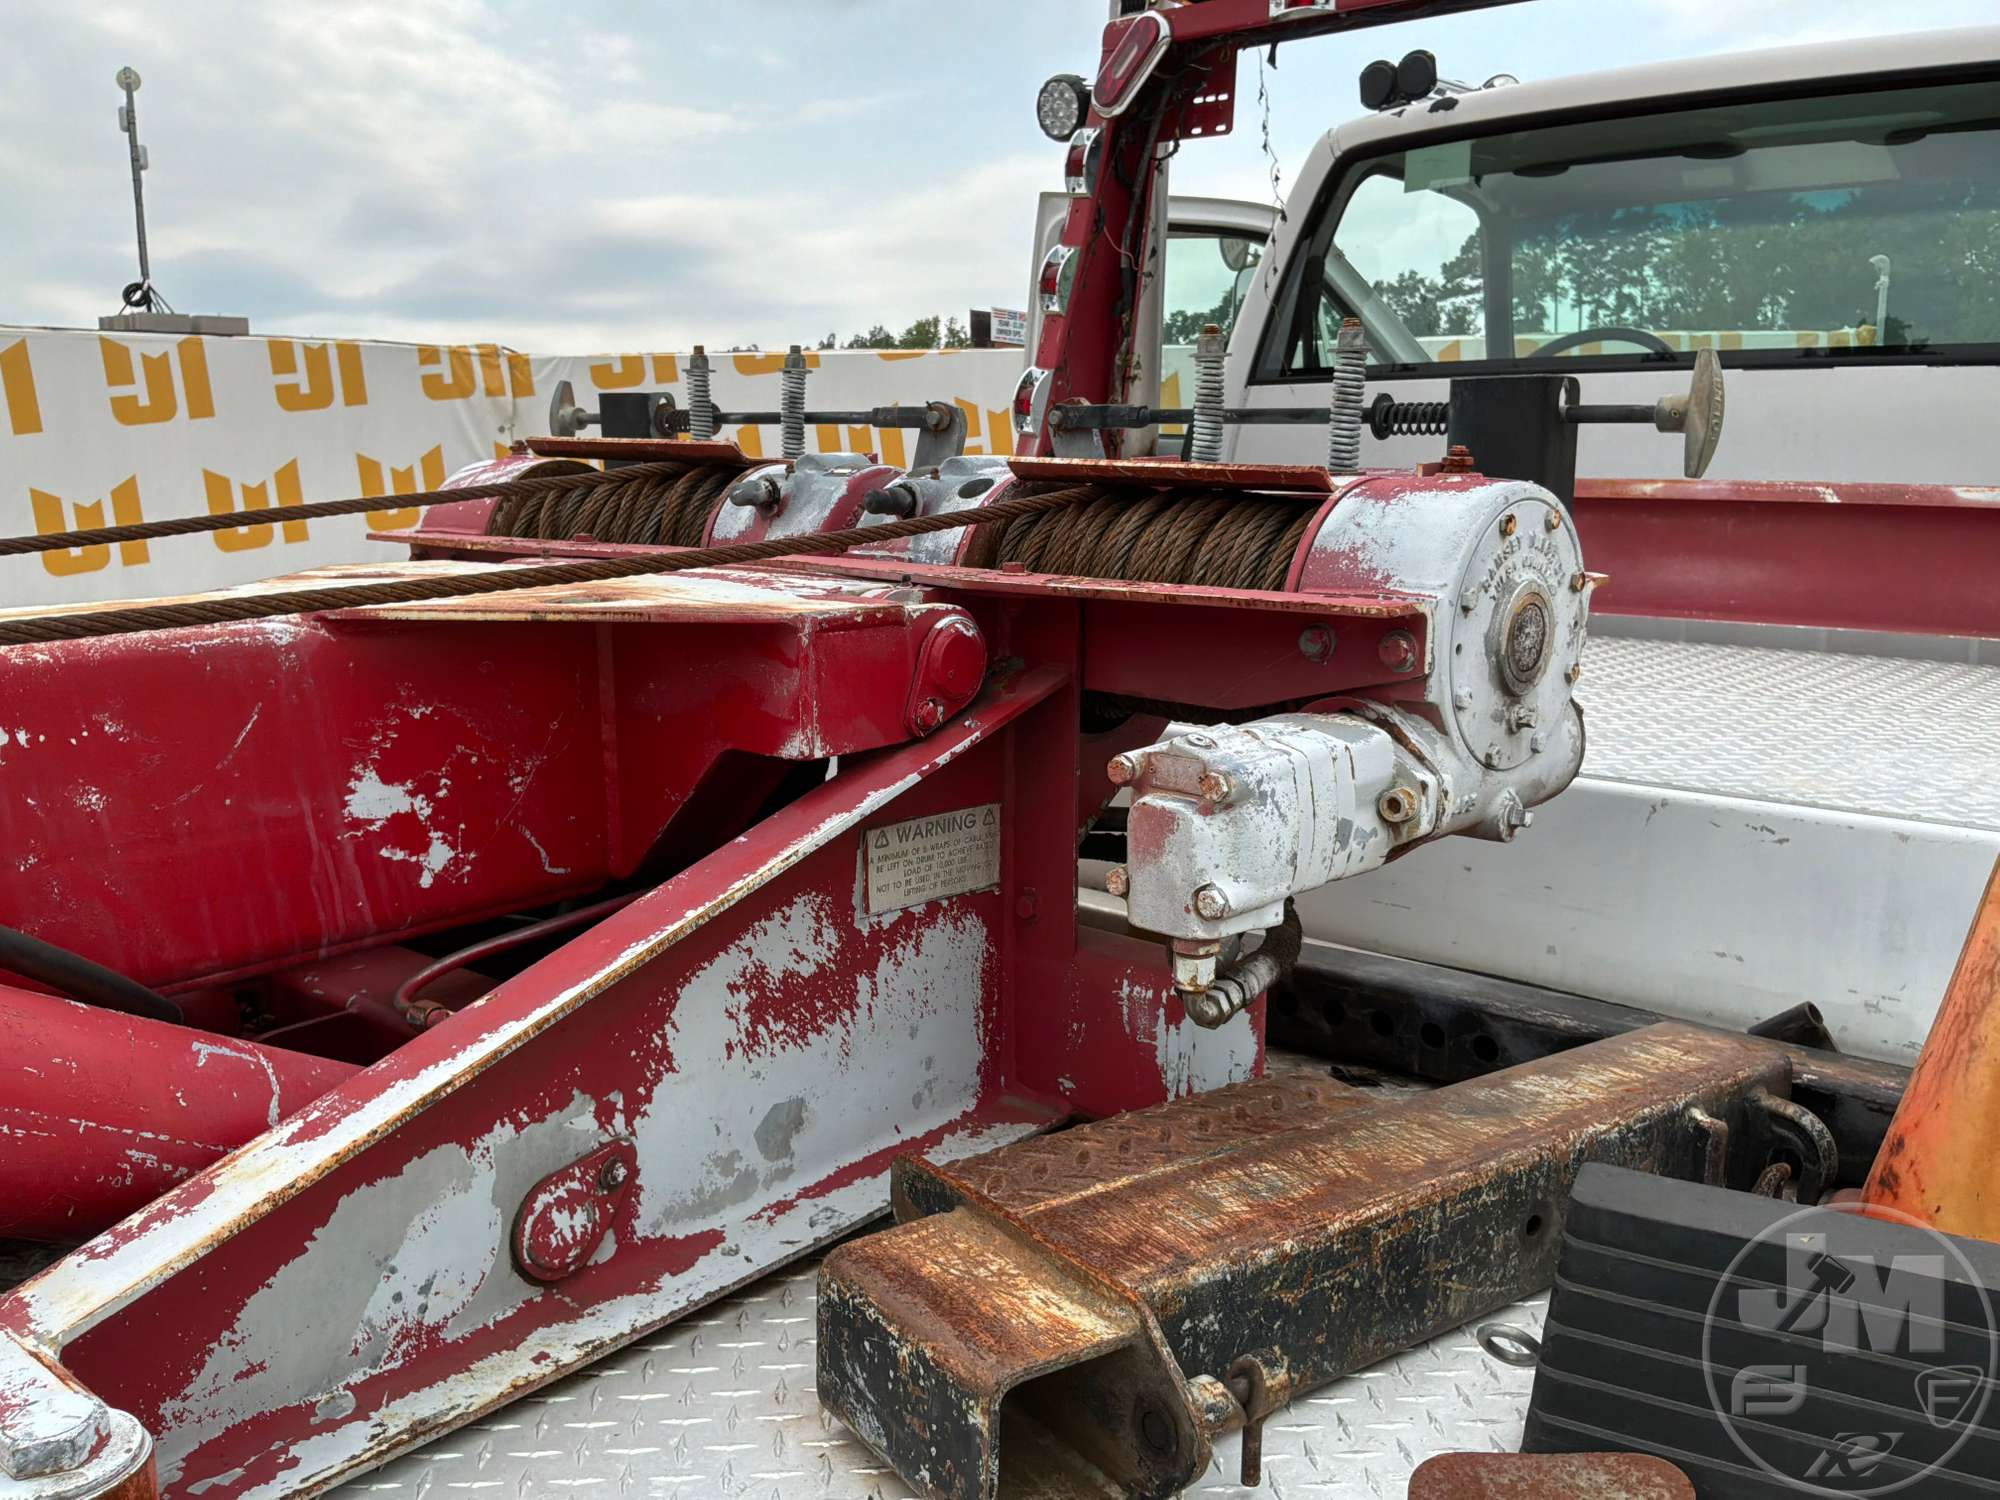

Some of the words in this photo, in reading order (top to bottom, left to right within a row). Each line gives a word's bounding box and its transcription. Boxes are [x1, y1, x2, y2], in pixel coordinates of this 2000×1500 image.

[896, 813, 976, 844] WARNING
[876, 865, 884, 874] BE
[887, 861, 900, 872] LEFT
[902, 858, 913, 868] ON
[916, 854, 935, 864] DRUM
[937, 851, 945, 860] TO
[877, 848, 909, 863] MINIMUM
[910, 847, 920, 856] OF
[929, 840, 952, 851] WRAPS
[877, 883, 890, 894] NOT
[893, 880, 902, 890] TO
[904, 878, 912, 887] BE
[933, 871, 941, 880] IN
[903, 866, 922, 877] LOAD
[903, 885, 926, 897] LIFTING
[929, 881, 939, 890] OF
